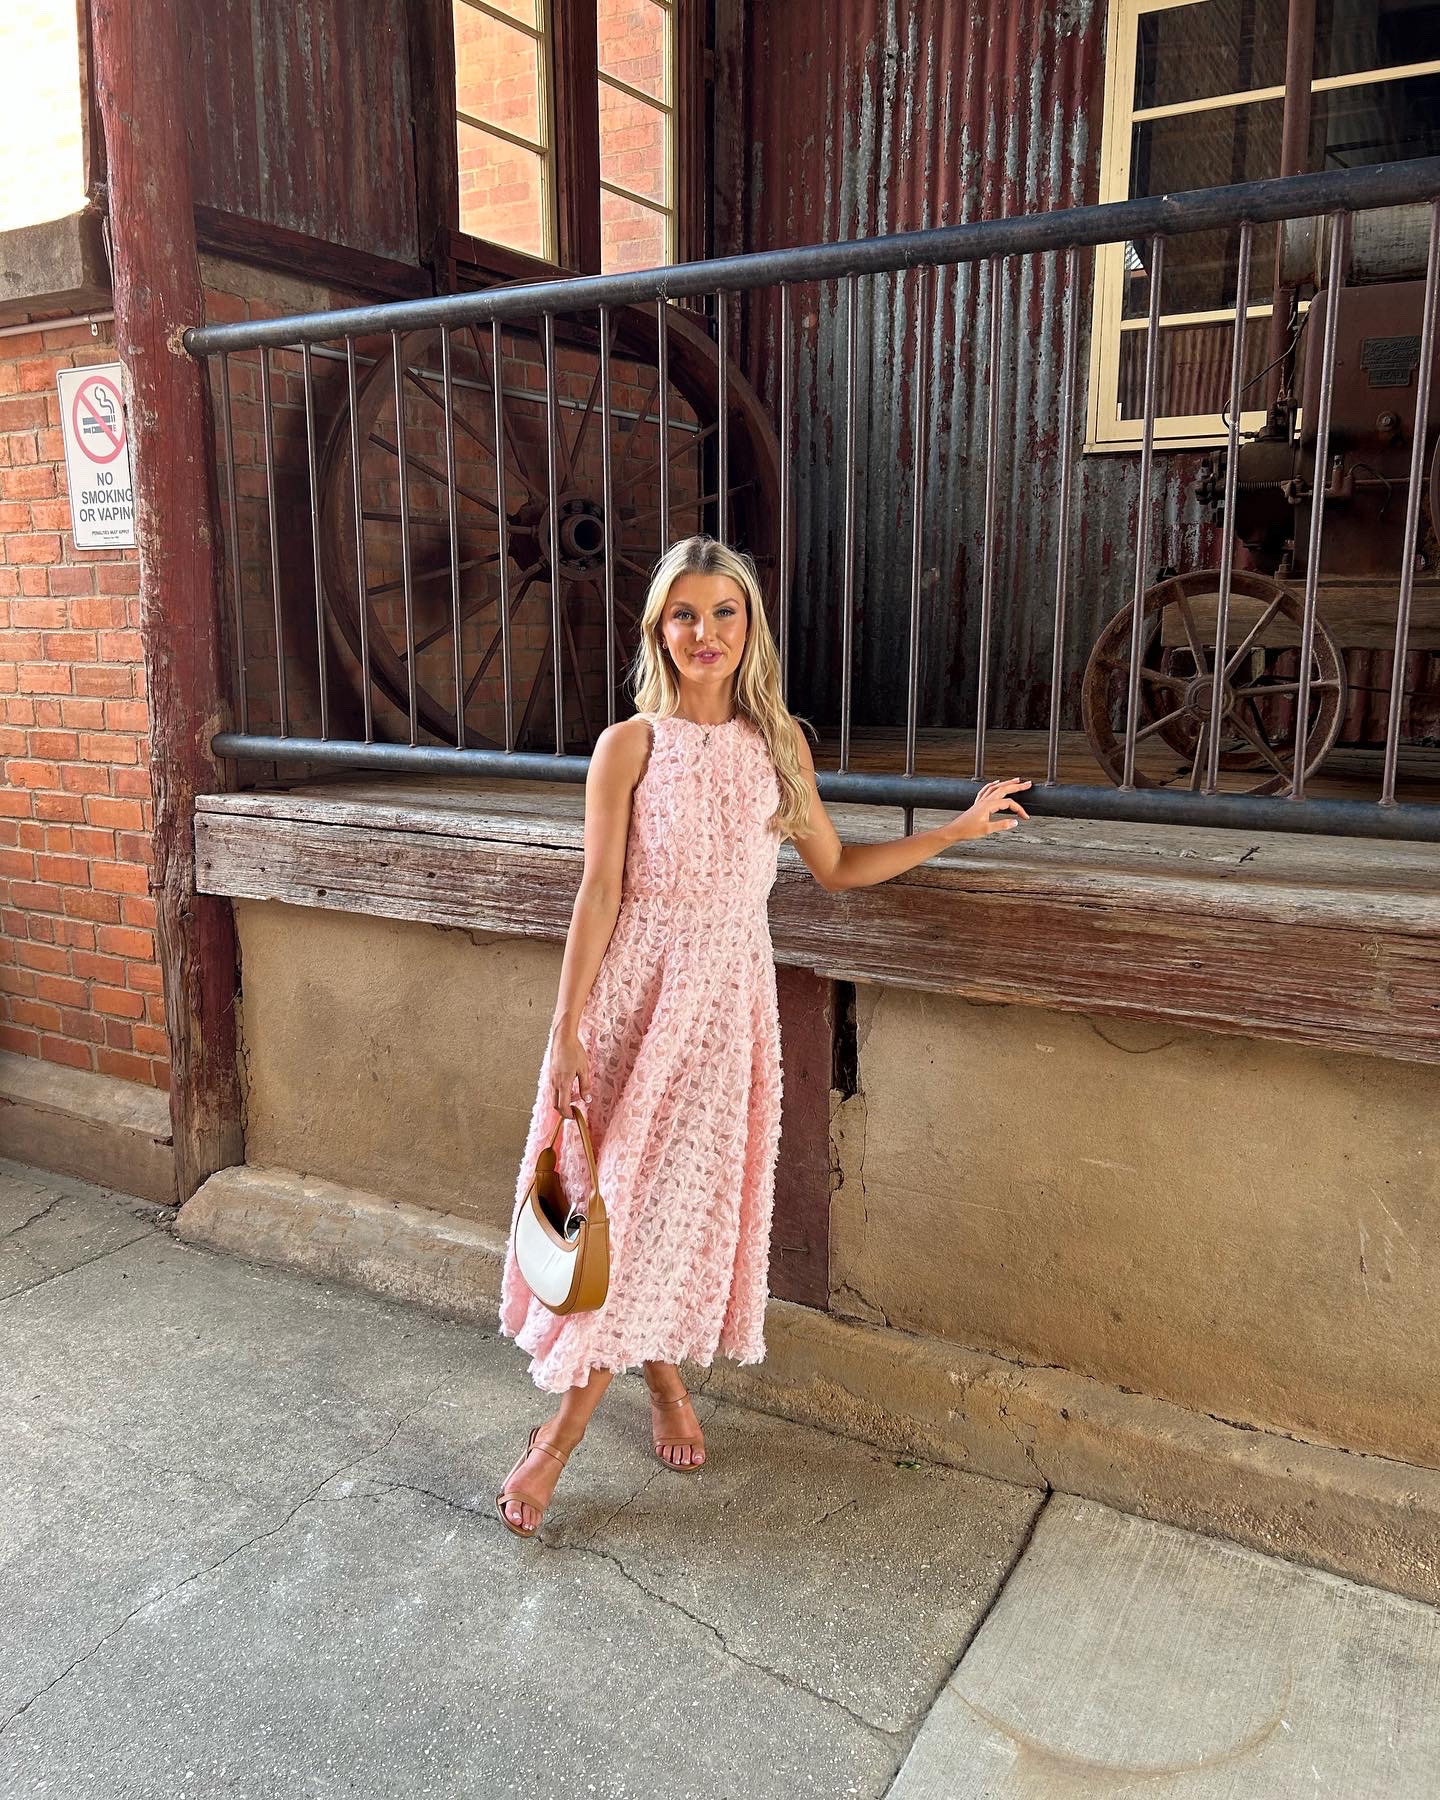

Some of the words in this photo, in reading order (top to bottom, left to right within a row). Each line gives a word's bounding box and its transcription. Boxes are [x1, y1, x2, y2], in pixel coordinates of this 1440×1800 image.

[96, 472, 113, 486] NO
[81, 488, 132, 504] SMOKING
[80, 509, 96, 521] OR
